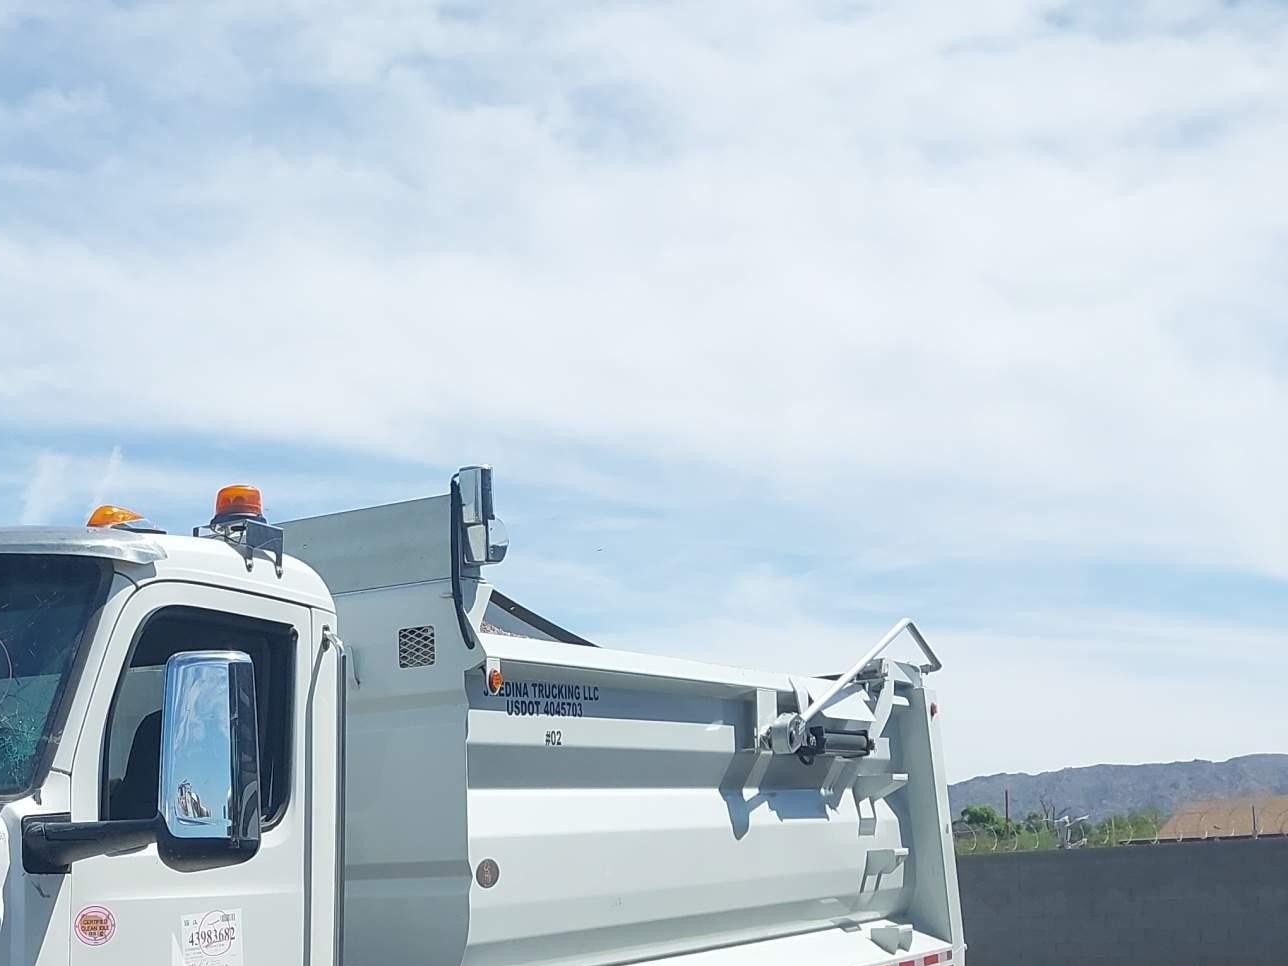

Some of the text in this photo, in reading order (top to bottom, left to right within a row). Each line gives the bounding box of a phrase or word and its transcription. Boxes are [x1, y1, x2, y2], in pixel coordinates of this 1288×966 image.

[483, 681, 599, 701] JEDINA TRUCKING LLC
[506, 700, 583, 718] USDOT 4045703
[545, 730, 562, 745] #02
[188, 926, 236, 946] 43983682
